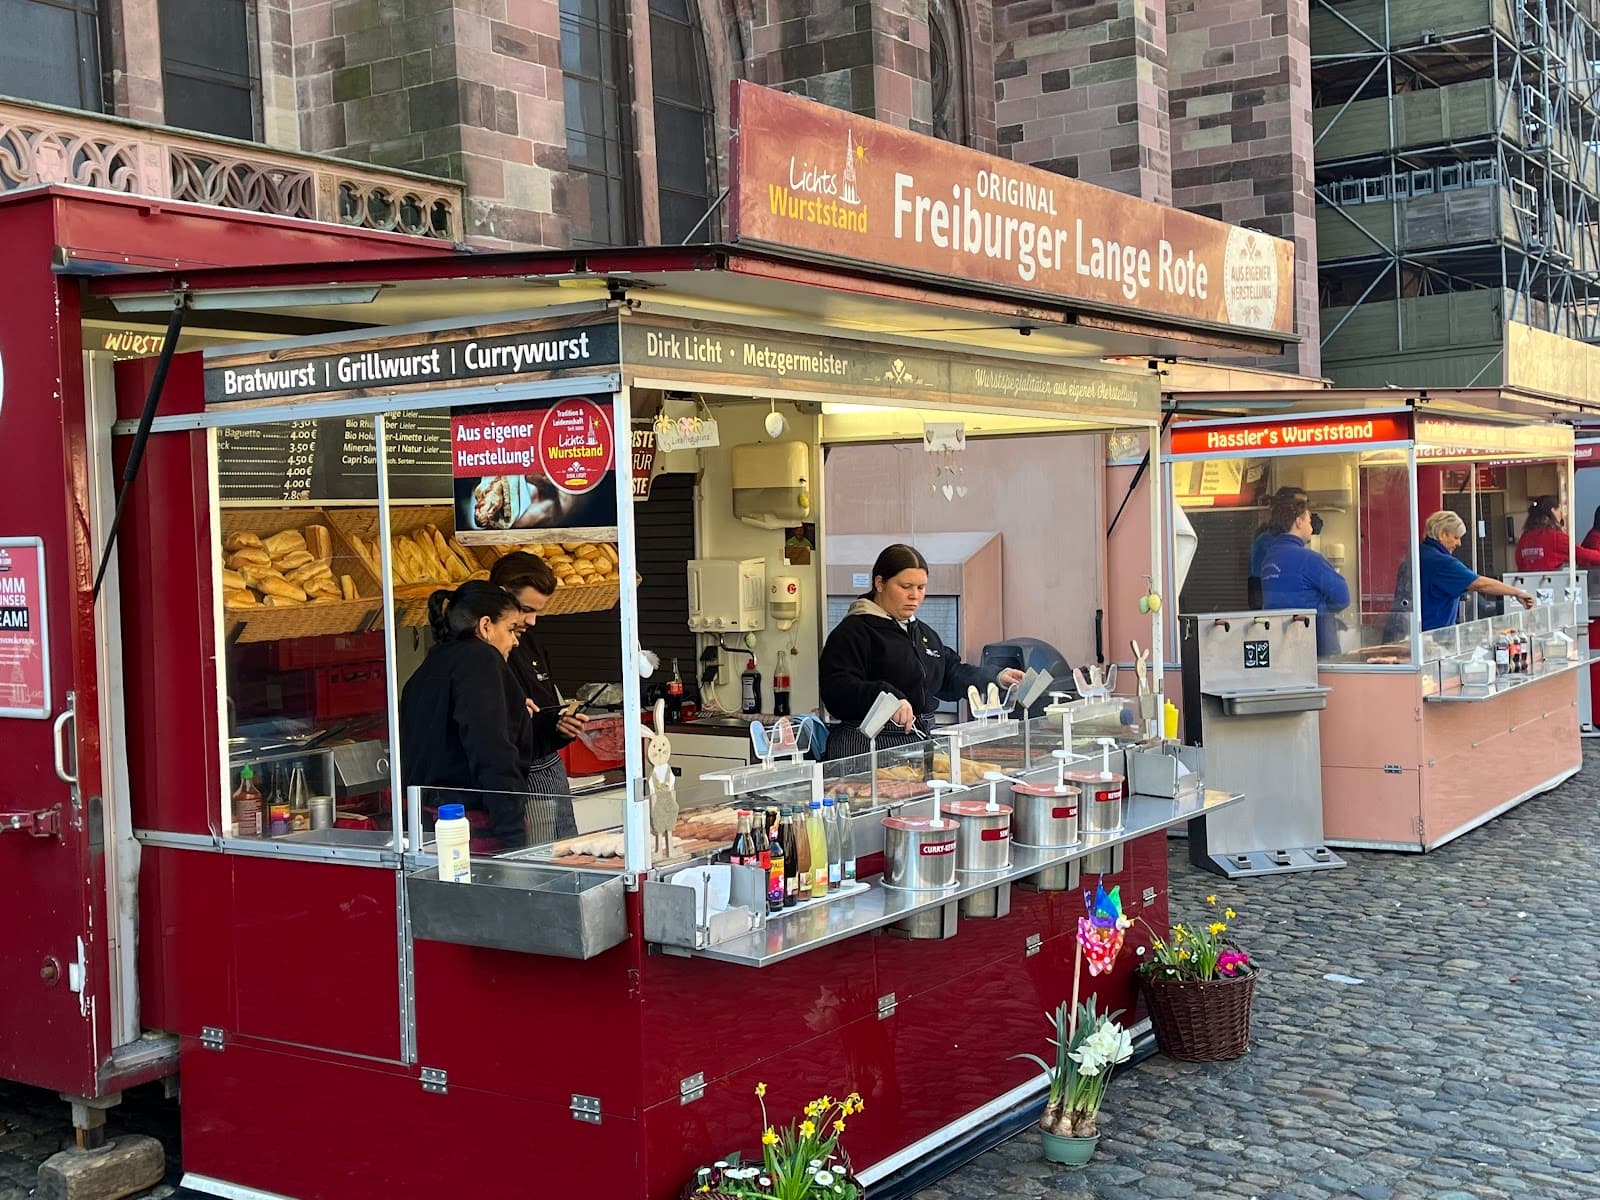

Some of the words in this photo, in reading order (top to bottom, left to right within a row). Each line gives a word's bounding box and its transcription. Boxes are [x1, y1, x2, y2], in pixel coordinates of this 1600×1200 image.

[789, 156, 838, 195] Lichts
[977, 170, 1057, 216] ORIGINAL
[769, 183, 868, 233] Wurststand
[894, 172, 1067, 281] Freiburger
[1076, 219, 1151, 300] Lange
[1159, 239, 1208, 300] Rote
[1231, 265, 1244, 281] AUS
[1245, 266, 1271, 281] EIGENER
[224, 362, 316, 395] Bratwurst
[337, 348, 440, 383] Grillwurst
[465, 332, 590, 373] Currywurst
[647, 332, 681, 359] Dirk
[685, 336, 722, 363] Licht
[743, 343, 849, 376] Metzgermeister
[975, 368, 1052, 397] Wurstspezialitäten
[1053, 382, 1067, 395] aus
[1069, 382, 1096, 402] eigener
[1097, 383, 1138, 408] Herstellung
[224, 428, 261, 440] Baguette
[345, 419, 358, 428] Bio
[456, 425, 480, 442] Aus
[483, 422, 533, 443] eigener
[344, 430, 357, 440] Bio
[558, 433, 584, 447] Lichts
[1207, 428, 1278, 448] Hassler's
[1282, 421, 1373, 443] Wurststand
[402, 445, 422, 453] Natur
[458, 446, 535, 467] Herstellung!
[548, 443, 603, 459] Wurststand
[342, 455, 362, 466] Capri
[363, 455, 377, 464] Sun
[632, 450, 652, 470] FÜR
